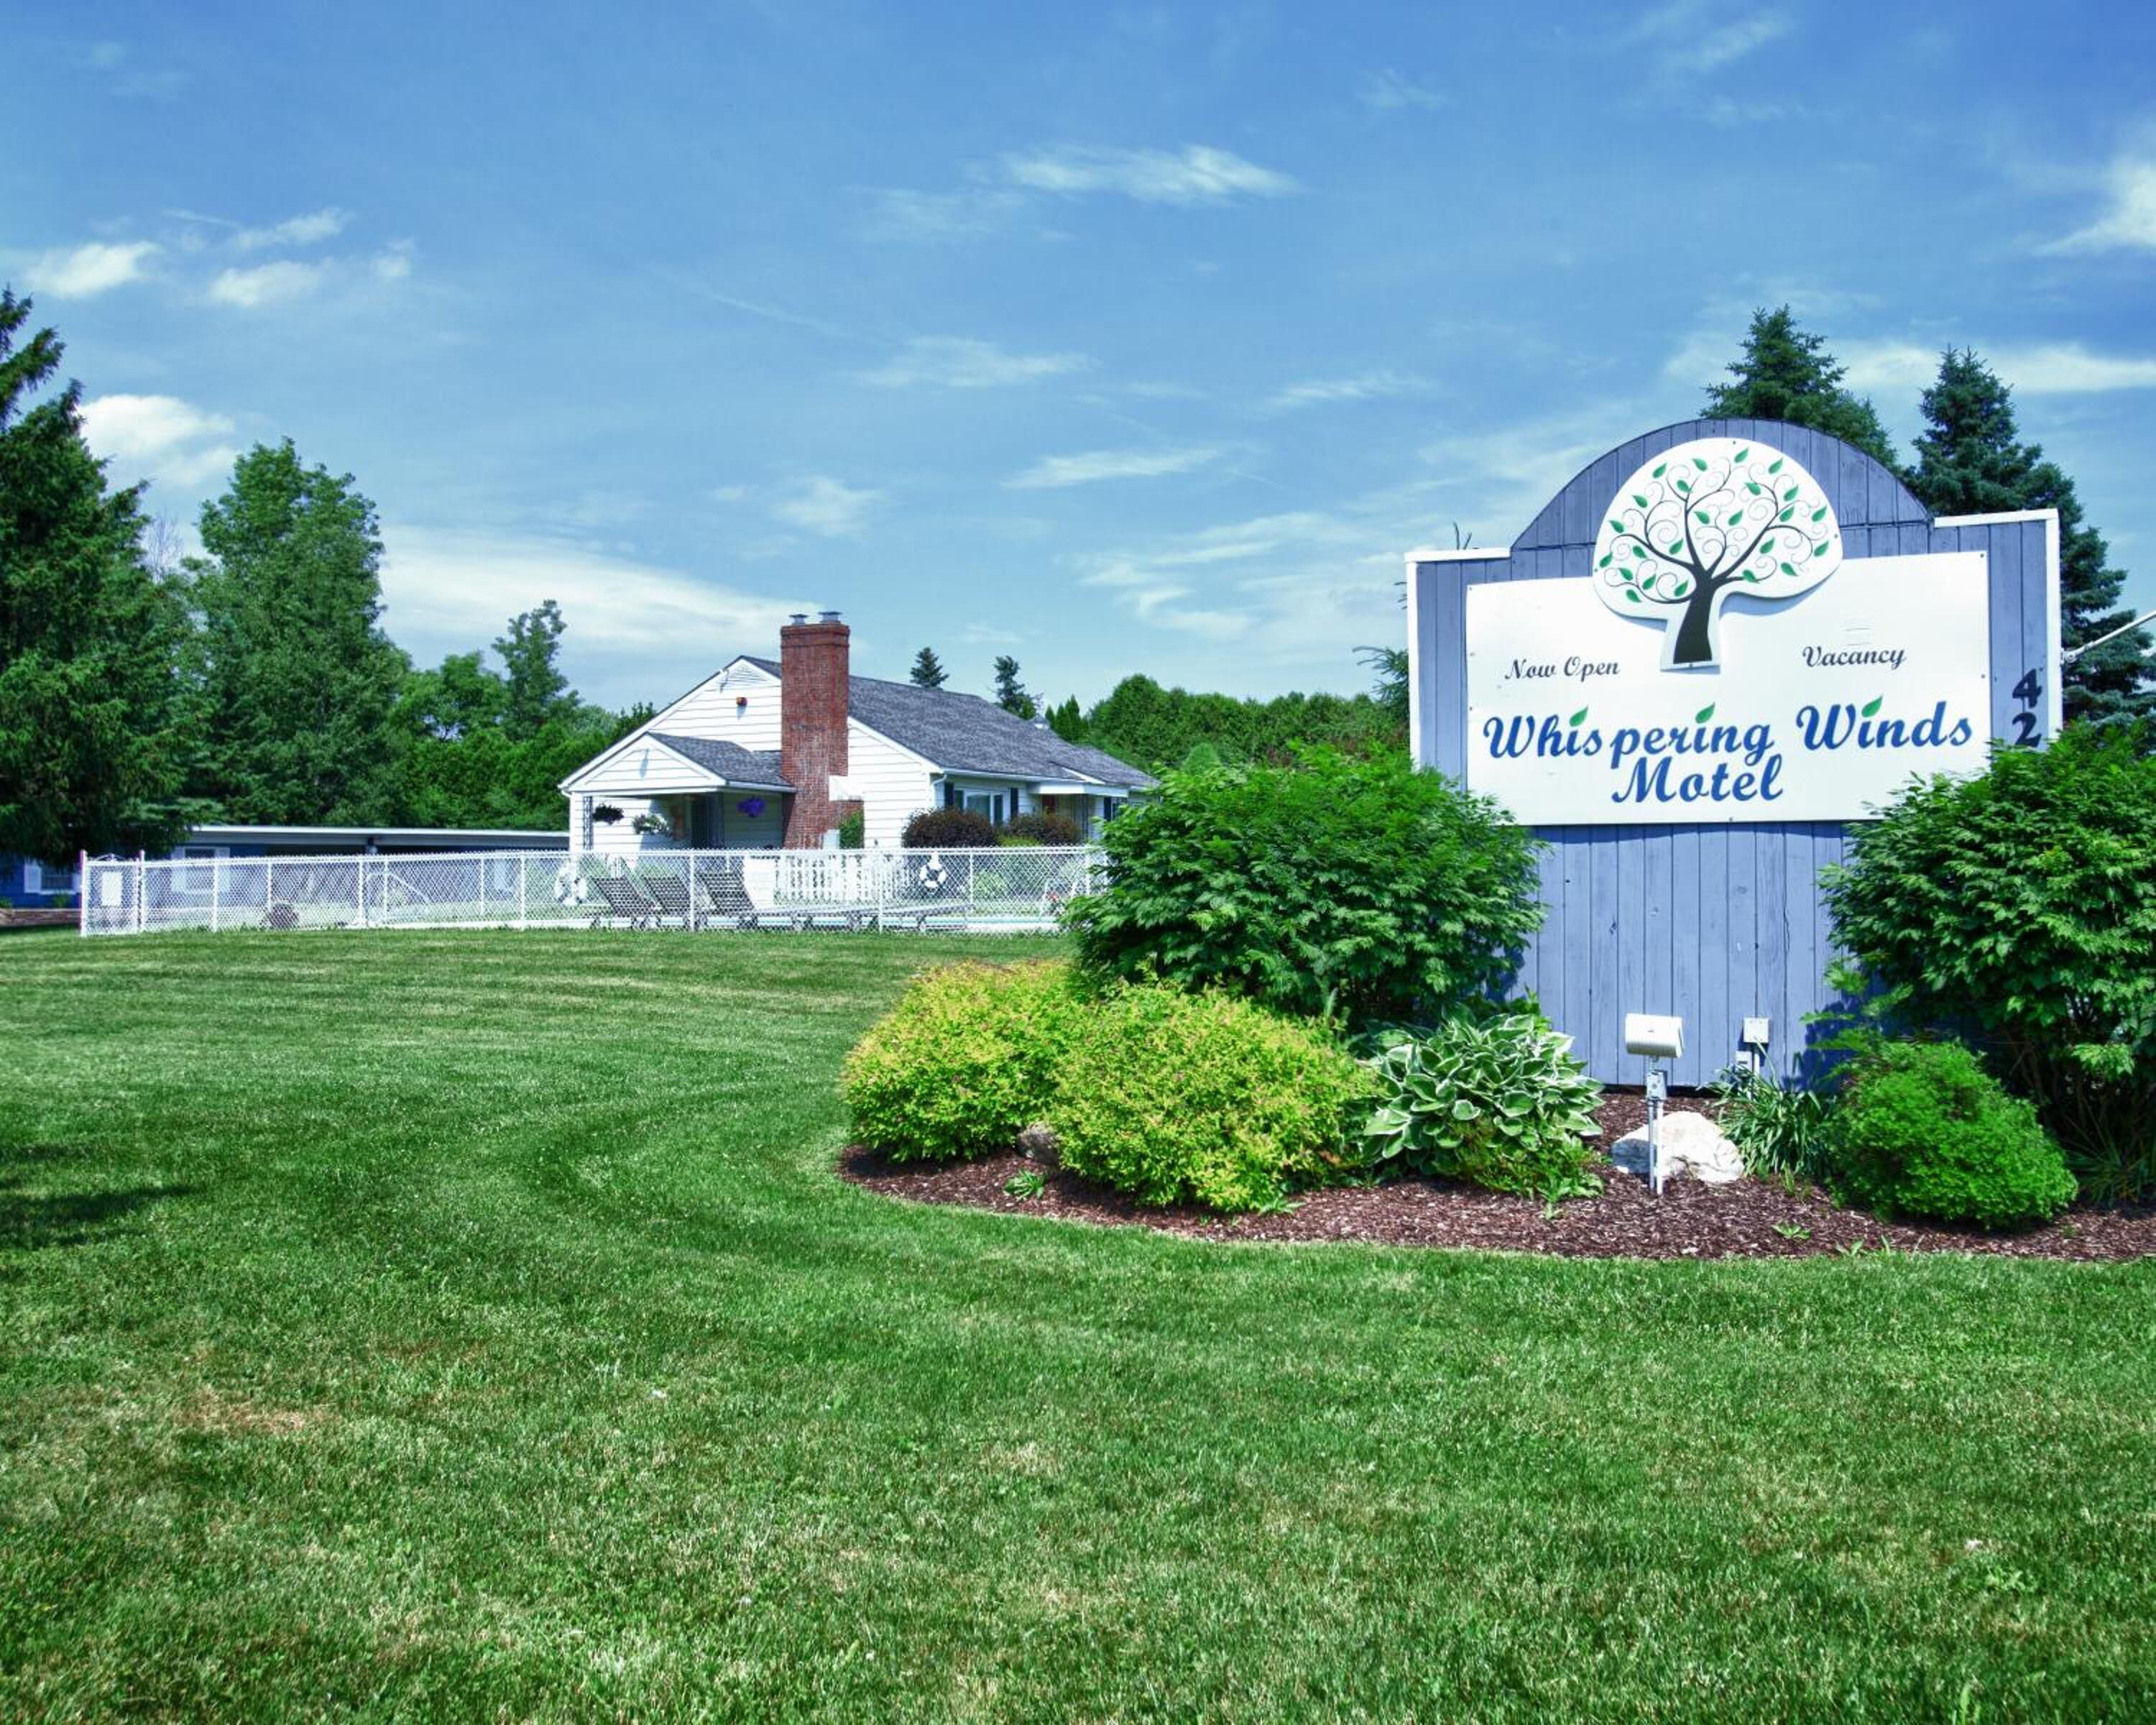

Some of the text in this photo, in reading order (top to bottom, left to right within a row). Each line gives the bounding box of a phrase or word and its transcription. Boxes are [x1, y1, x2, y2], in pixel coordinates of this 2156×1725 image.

[1505, 656, 1621, 682] Now Open
[1802, 645, 1907, 671] Vacancy
[1796, 695, 1973, 751] Winds
[1611, 753, 1783, 804] Motel
